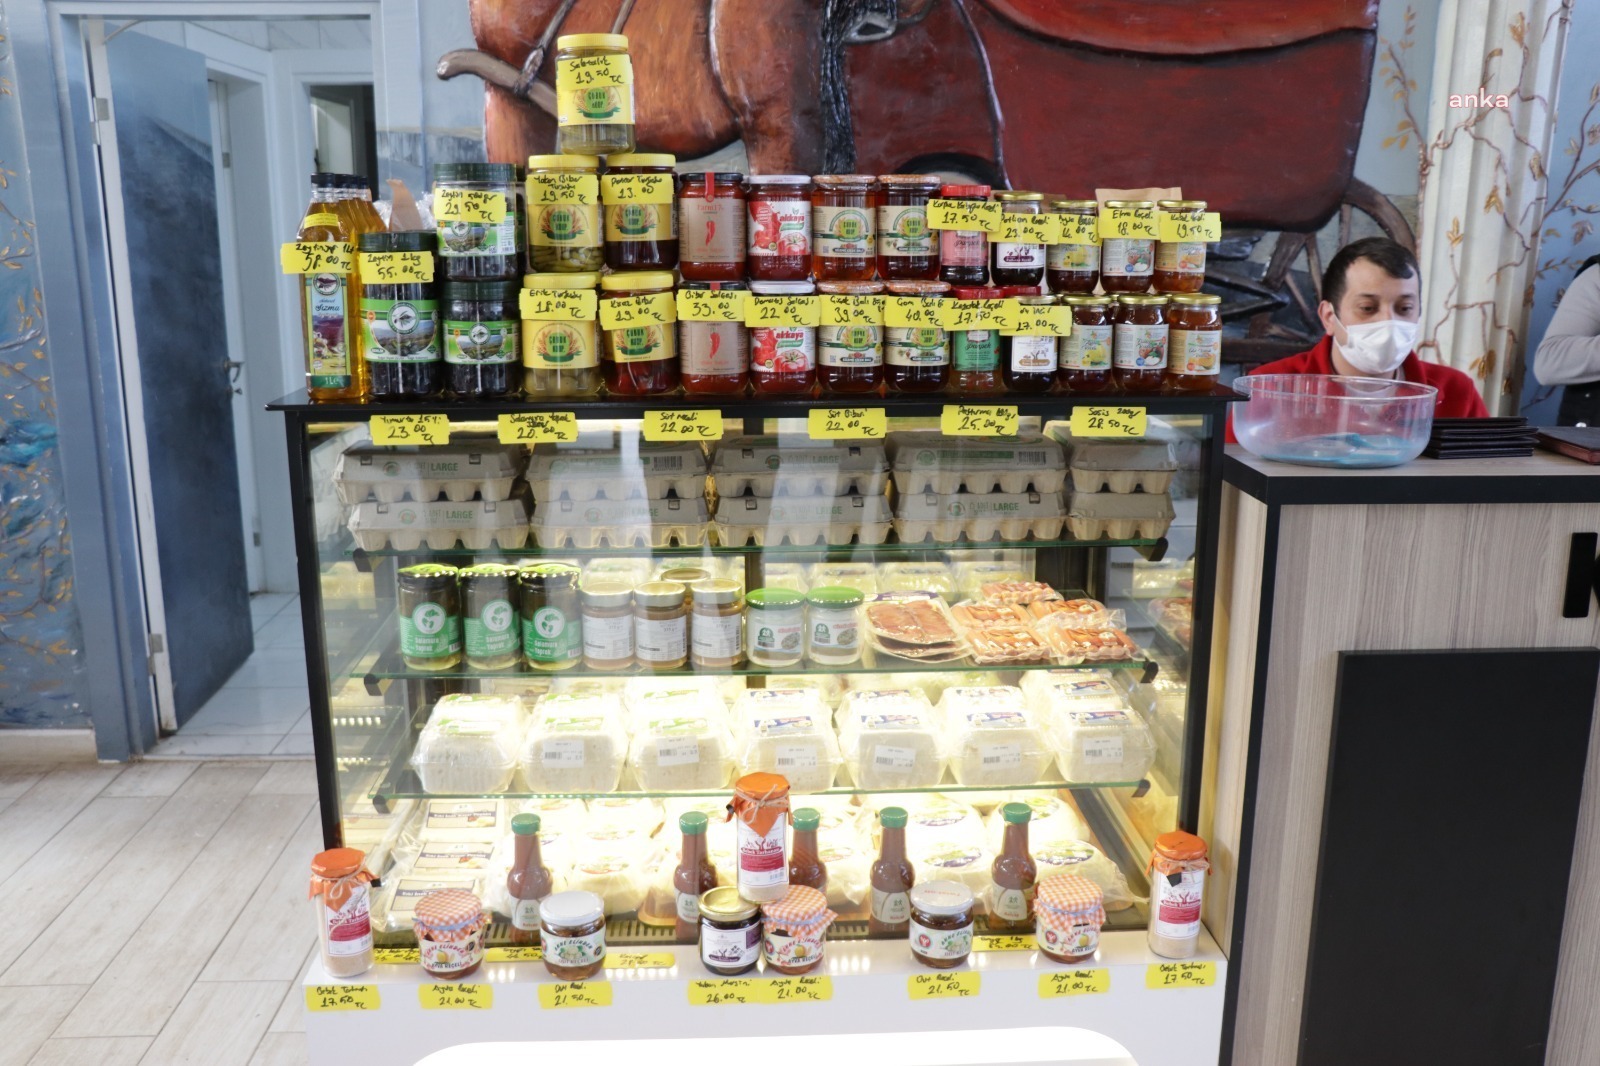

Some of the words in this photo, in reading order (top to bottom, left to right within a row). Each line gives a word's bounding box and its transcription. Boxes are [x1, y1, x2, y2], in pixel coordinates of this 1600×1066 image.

[431, 462, 458, 471] LARGE
[993, 502, 1019, 511] LARGE
[446, 510, 472, 519] LARGE
